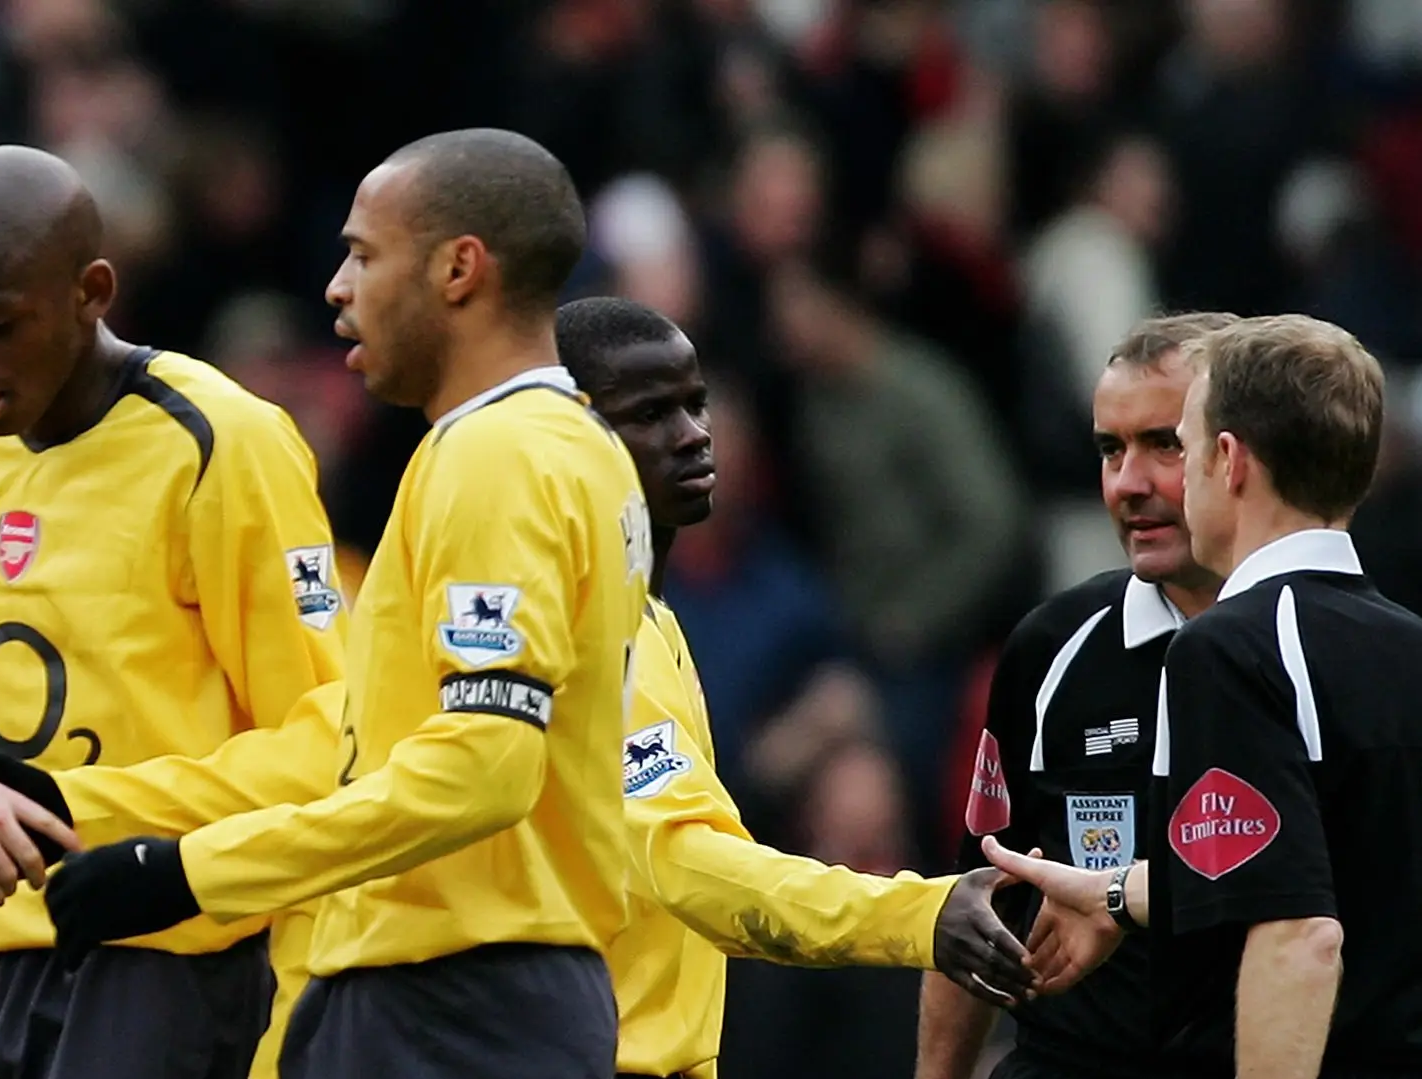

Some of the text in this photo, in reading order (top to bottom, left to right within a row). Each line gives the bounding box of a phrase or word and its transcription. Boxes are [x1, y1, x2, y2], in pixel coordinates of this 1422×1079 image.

[1071, 799, 1128, 809] ASSISTANT
[1201, 792, 1235, 816] Fly
[1076, 811, 1124, 822] REFEREE
[1180, 815, 1266, 844] Emirates
[1085, 856, 1120, 871] FIFA
